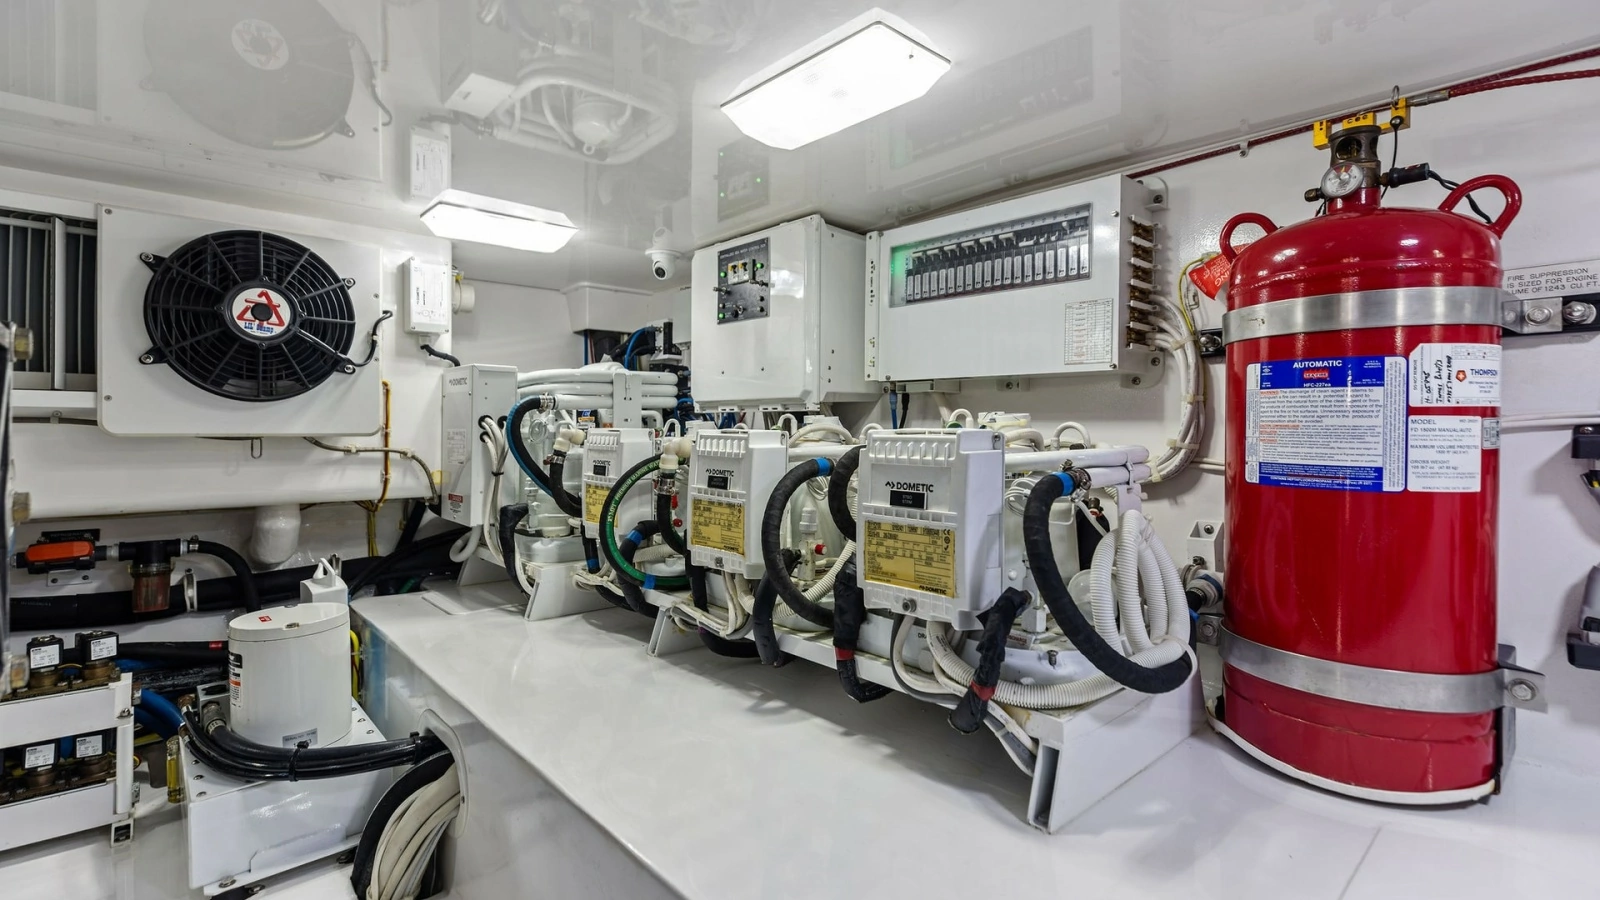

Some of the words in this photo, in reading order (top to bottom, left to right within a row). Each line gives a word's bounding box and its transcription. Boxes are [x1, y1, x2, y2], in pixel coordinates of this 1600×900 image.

[1530, 268, 1588, 279] SUPPRESSION
[1518, 280, 1542, 288] SIZED
[1566, 274, 1598, 282] ENGINE
[1293, 360, 1342, 368] AUTOMATIC
[896, 482, 934, 492] DOMETIC
[926, 586, 947, 595] DOMETIC
